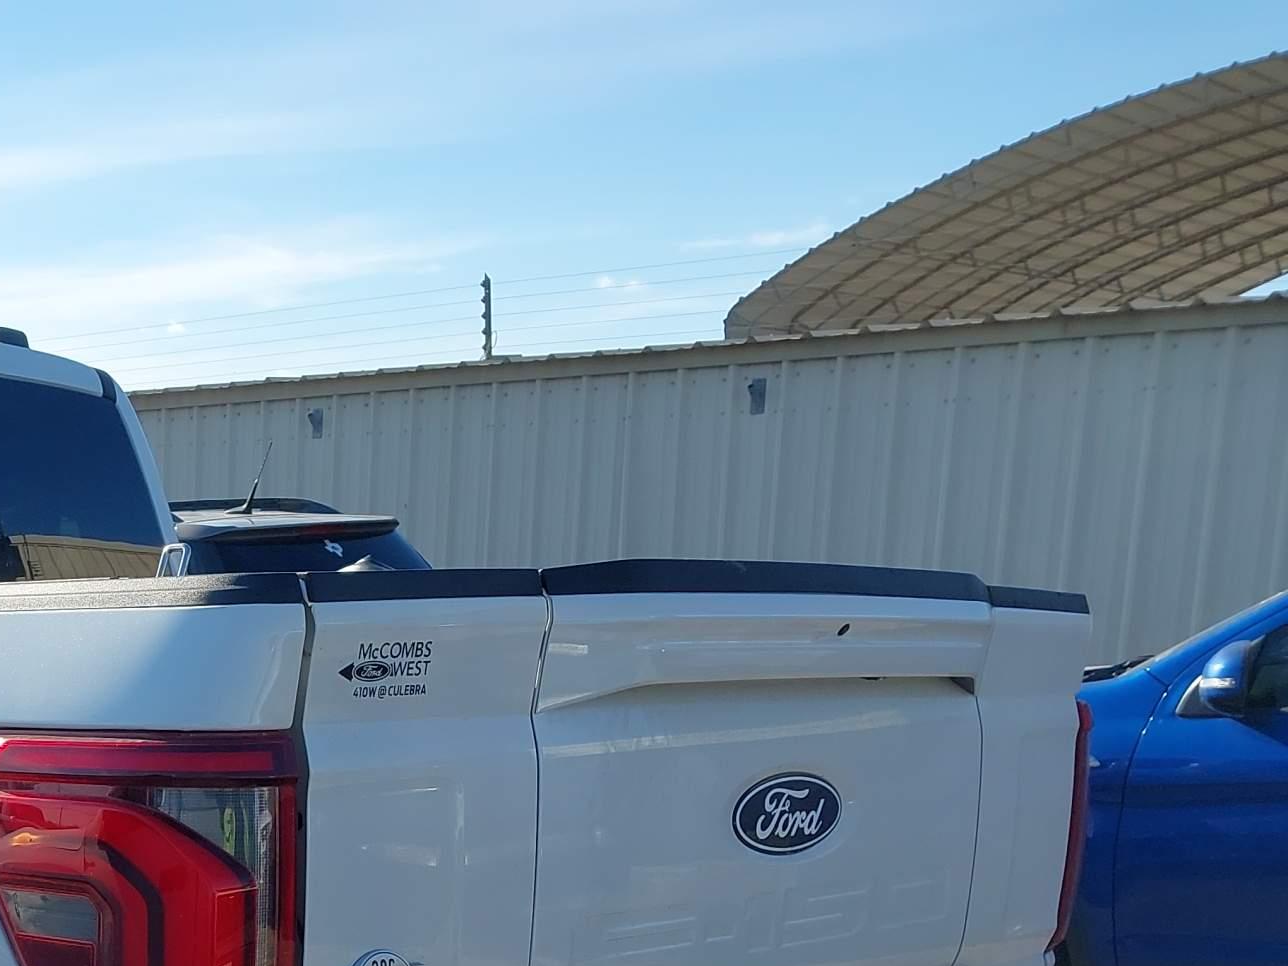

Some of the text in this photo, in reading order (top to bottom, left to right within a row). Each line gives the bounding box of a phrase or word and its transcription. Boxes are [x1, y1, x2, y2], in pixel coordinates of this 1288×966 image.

[357, 641, 433, 660] McCOMBS
[393, 660, 432, 677] WEST
[755, 787, 825, 840] Ford
